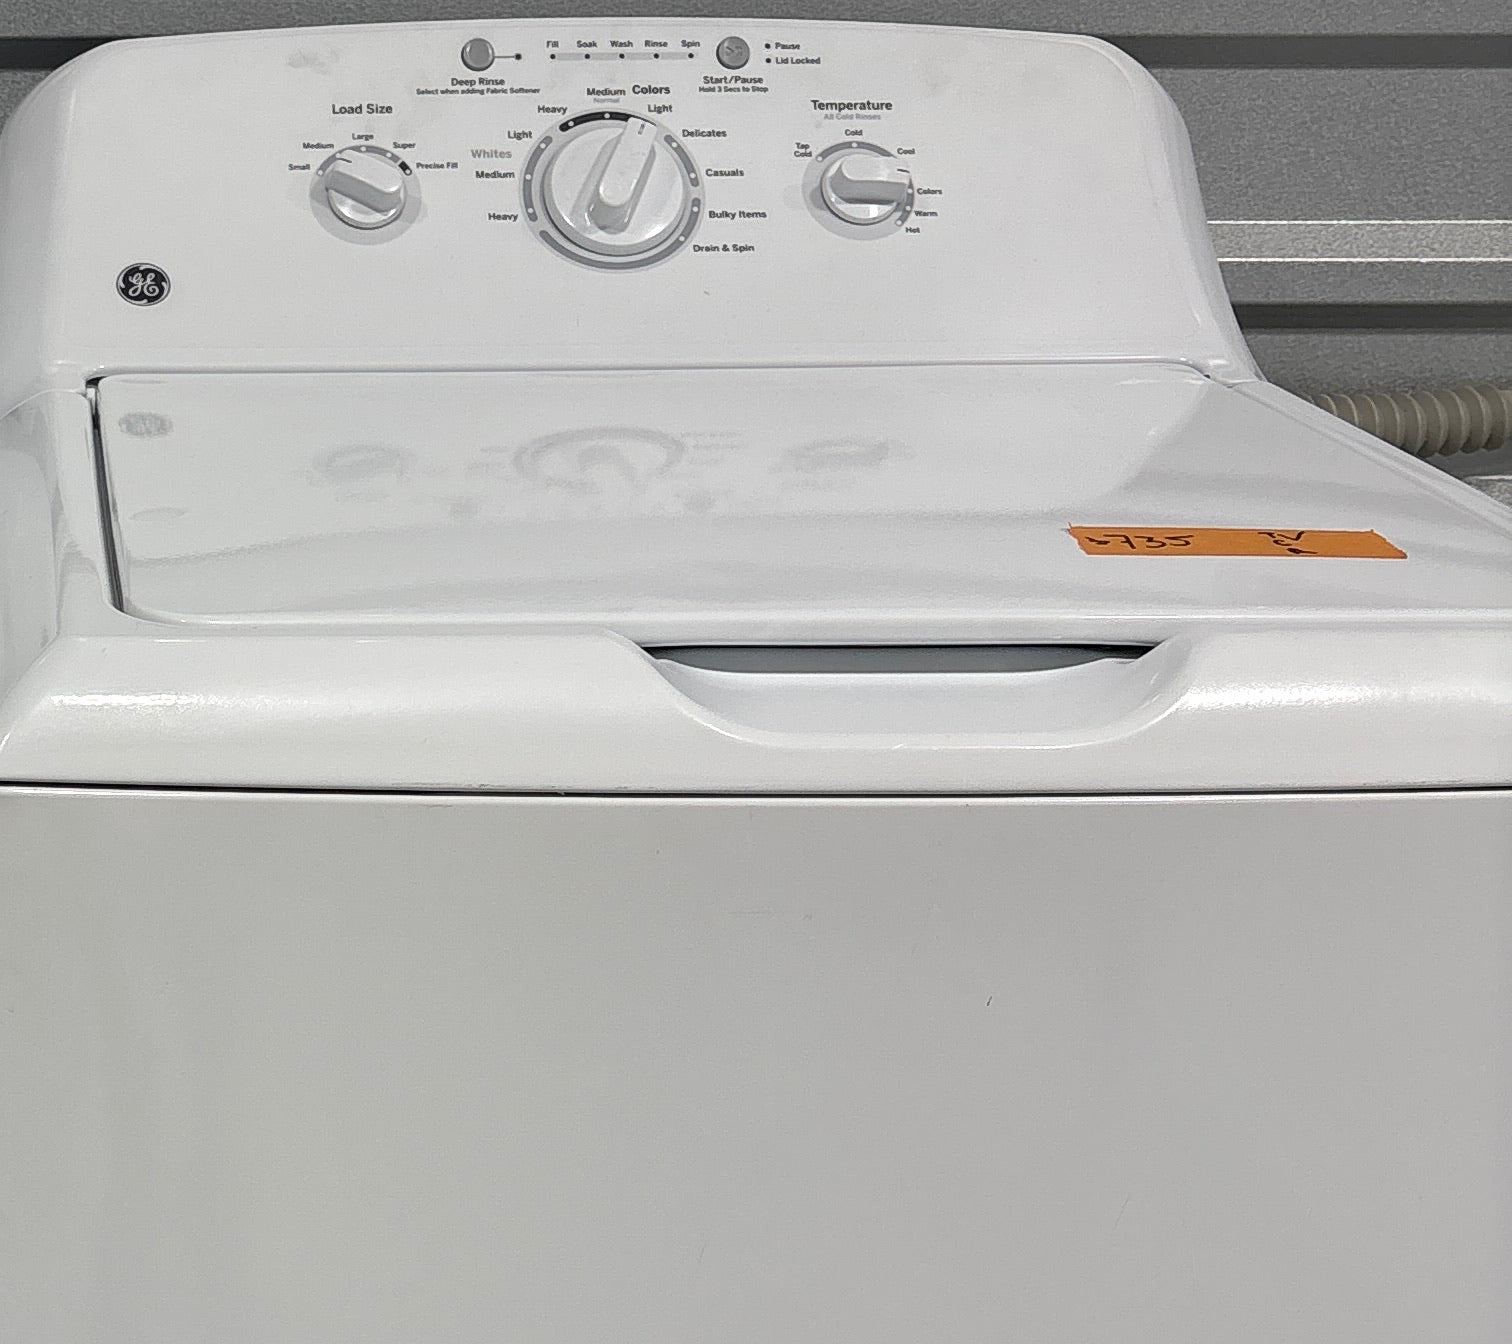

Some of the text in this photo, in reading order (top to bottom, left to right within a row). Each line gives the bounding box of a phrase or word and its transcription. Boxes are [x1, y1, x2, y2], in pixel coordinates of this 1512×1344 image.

[577, 40, 597, 48] Soak
[681, 40, 700, 48] Spin
[775, 42, 800, 50] Pause
[451, 78, 476, 87] Deep
[703, 76, 763, 84] Start/Pause
[587, 88, 626, 96] Medium
[632, 85, 670, 94] Colors
[332, 104, 392, 114] Load Size
[538, 105, 568, 115] Heavy
[648, 104, 672, 114] Light
[810, 100, 892, 112] Temperature
[352, 133, 374, 141] Large
[508, 131, 532, 141] Light
[682, 129, 727, 137] Delicates
[471, 149, 512, 158] Whites
[706, 169, 744, 177] Casuals
[488, 213, 518, 222] Heavy
[709, 211, 736, 220] Bulky
[722, 244, 730, 252] &
[732, 244, 755, 253] Spin
